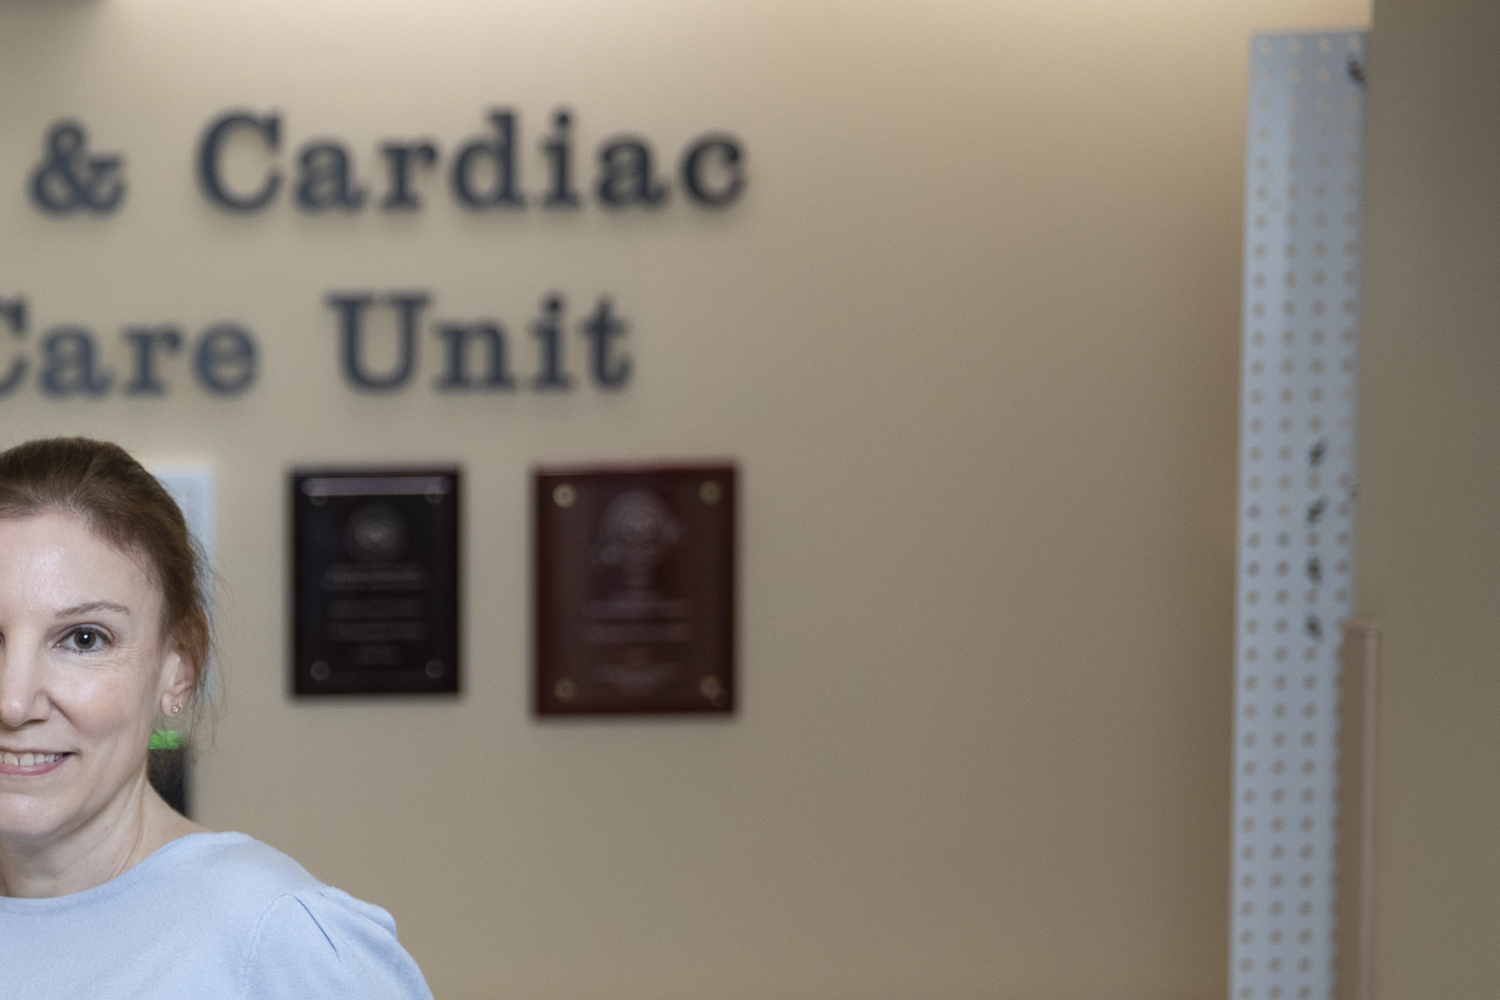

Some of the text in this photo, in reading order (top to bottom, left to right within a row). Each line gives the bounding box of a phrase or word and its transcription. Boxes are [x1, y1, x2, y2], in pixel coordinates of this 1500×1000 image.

[28, 120, 126, 216] &
[194, 108, 747, 216] Cardiac
[327, 293, 633, 393] Unit
